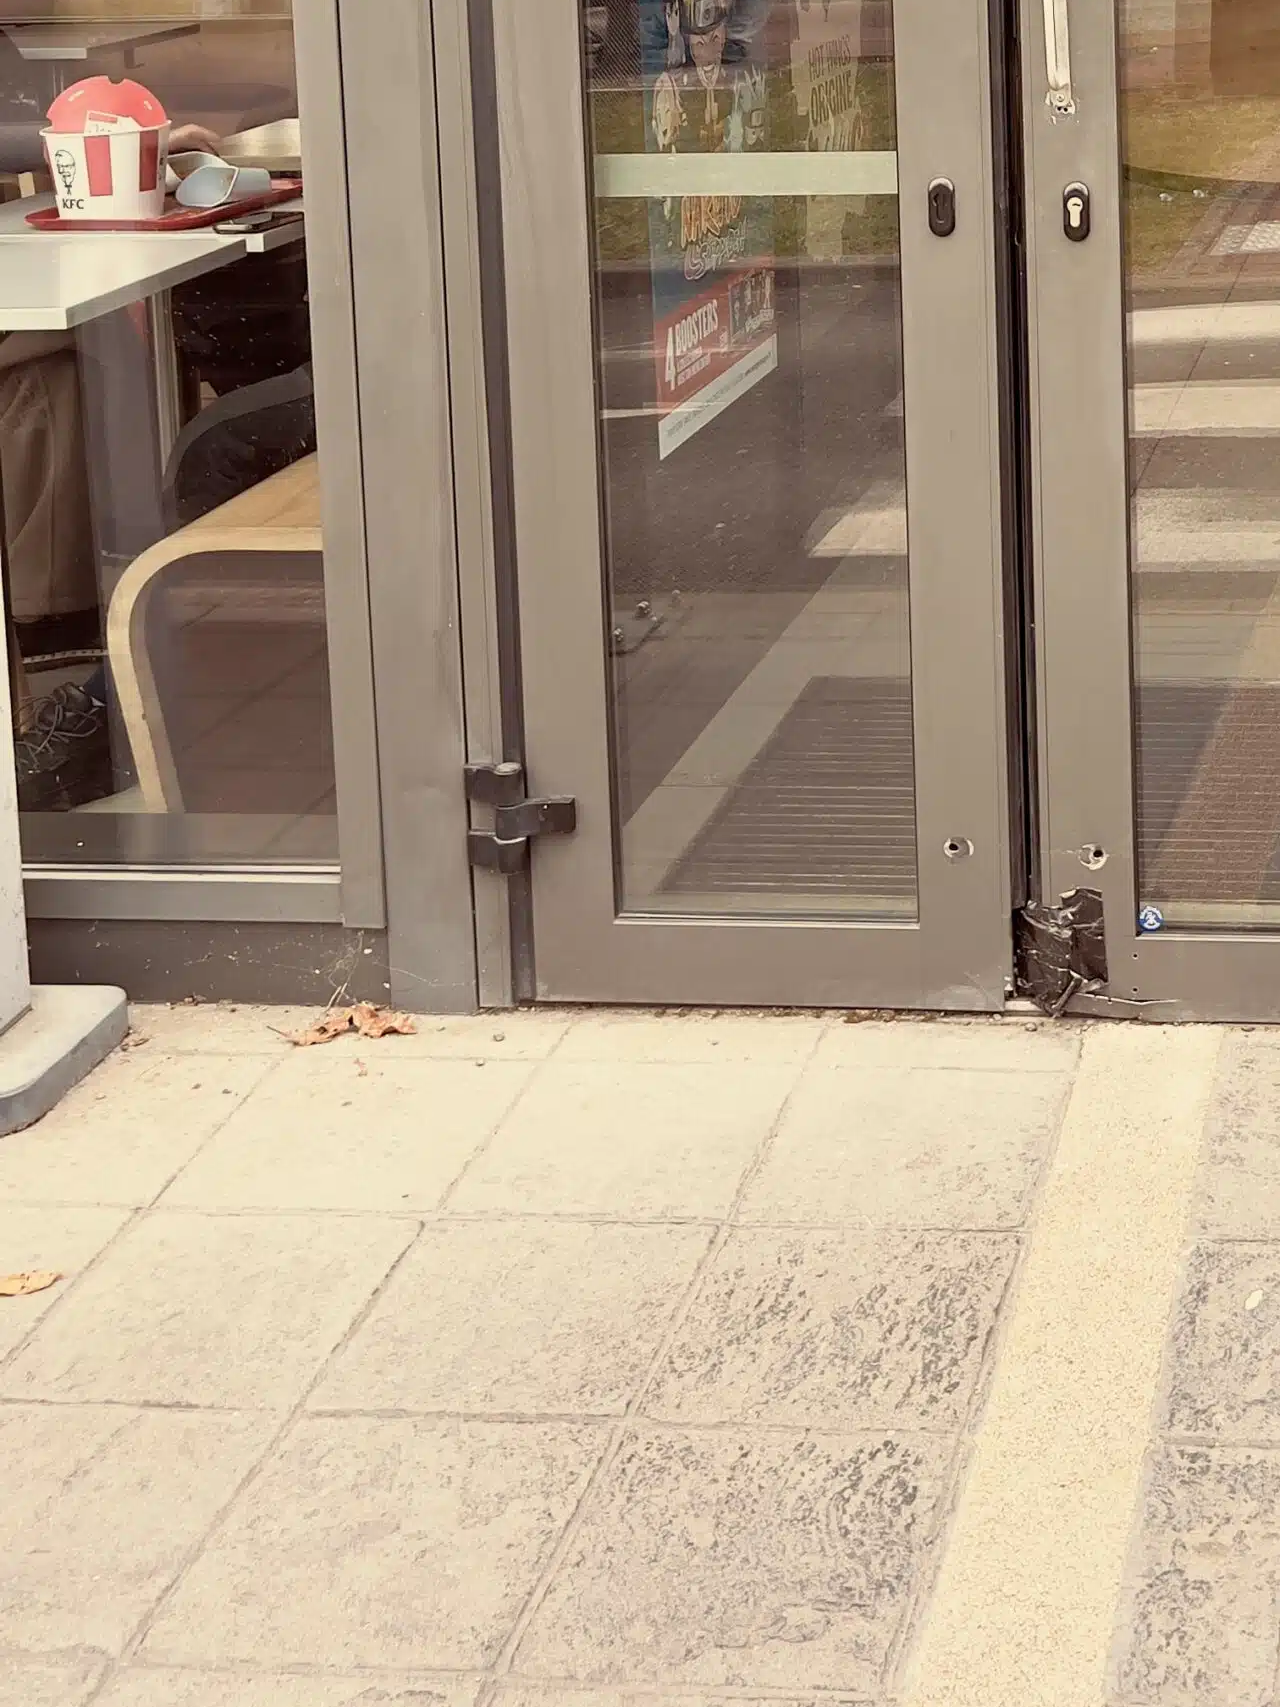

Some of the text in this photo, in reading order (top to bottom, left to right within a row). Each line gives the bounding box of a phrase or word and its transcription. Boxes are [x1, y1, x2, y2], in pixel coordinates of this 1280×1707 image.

[810, 69, 853, 128] ORIGINE
[62, 198, 85, 210] KFC
[665, 326, 676, 390] 4
[675, 299, 719, 356] BOOSTERS
